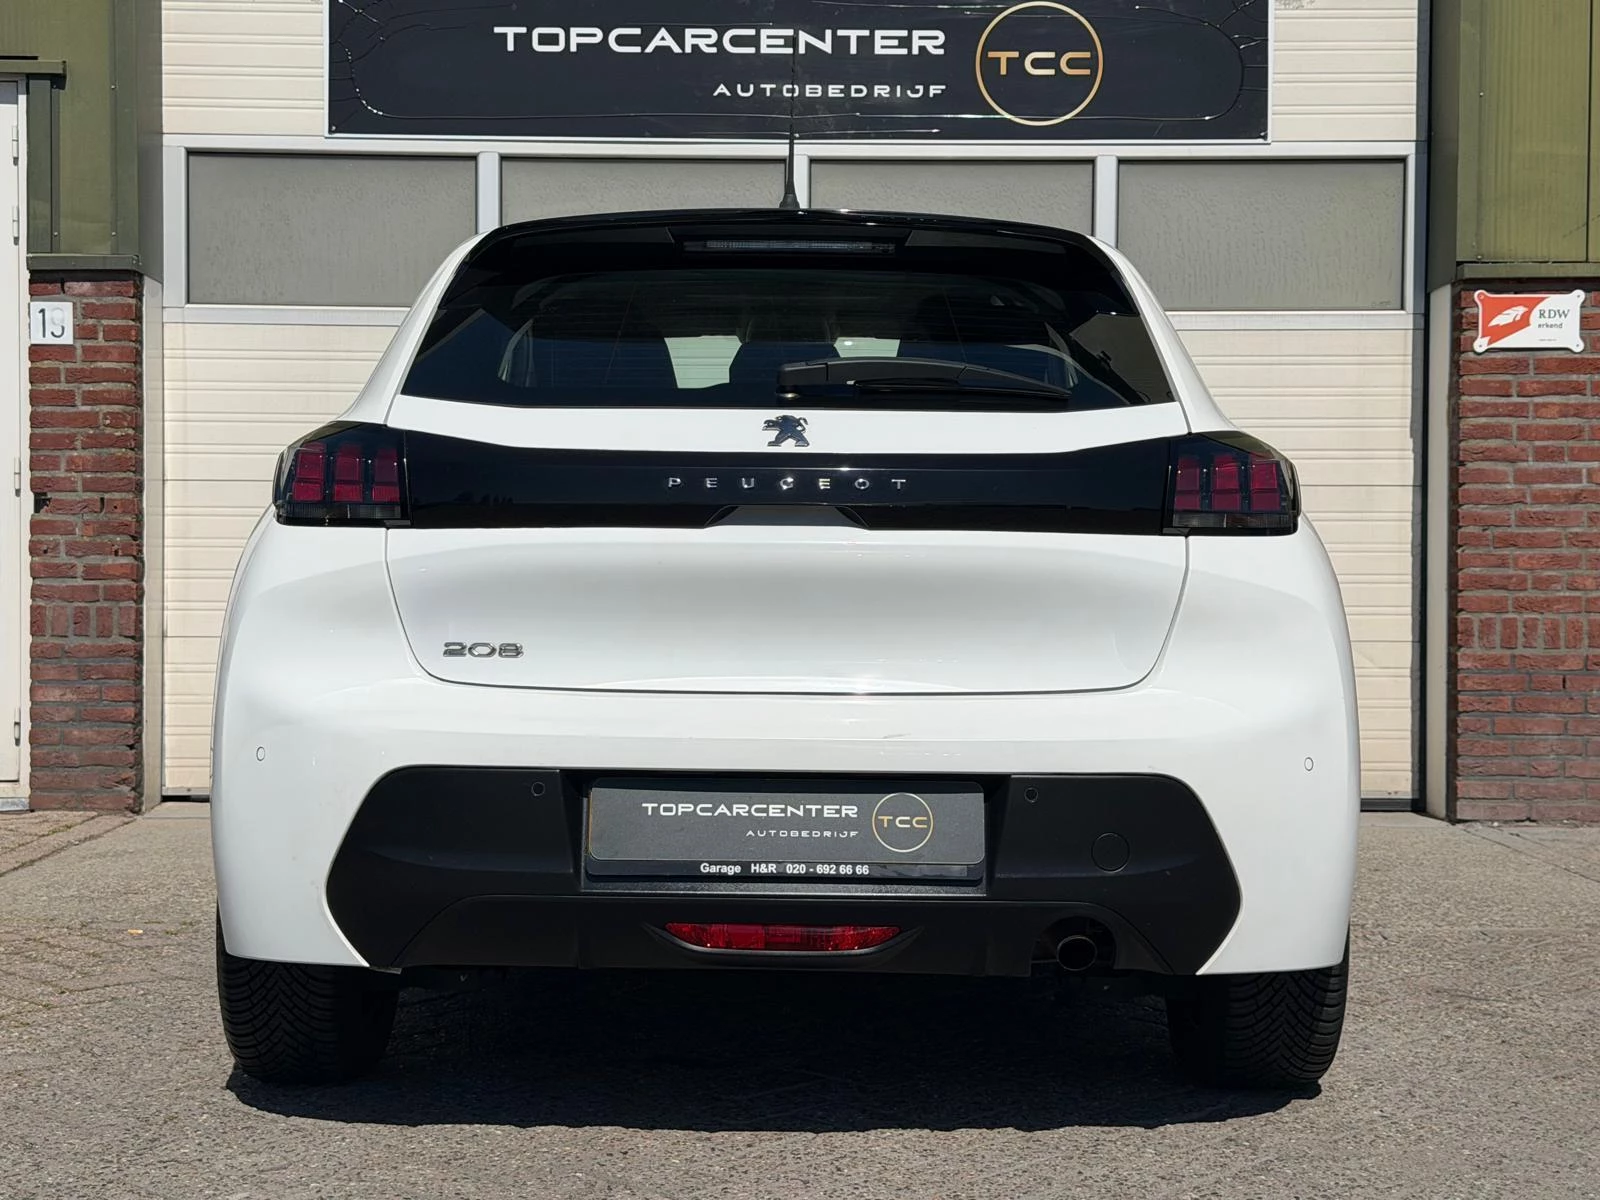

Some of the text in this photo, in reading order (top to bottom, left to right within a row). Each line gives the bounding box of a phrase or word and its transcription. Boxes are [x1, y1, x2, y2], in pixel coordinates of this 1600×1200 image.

[493, 27, 946, 55] TOPCARCENTER
[988, 51, 1091, 75] TCC
[712, 83, 947, 98] AUTOBEDRIJF
[1539, 309, 1570, 318] RDW
[668, 477, 906, 489] PEUGEOT
[442, 641, 524, 658] 208
[642, 803, 858, 817] TOPCARCENTER
[878, 816, 928, 828] TCC
[746, 830, 859, 838] AUTOBEDRIJF
[700, 863, 741, 875] Garage
[750, 864, 777, 874] H&R
[786, 864, 806, 874] 020
[816, 865, 836, 874] 692
[839, 865, 853, 875] 66
[855, 865, 870, 875] 66
